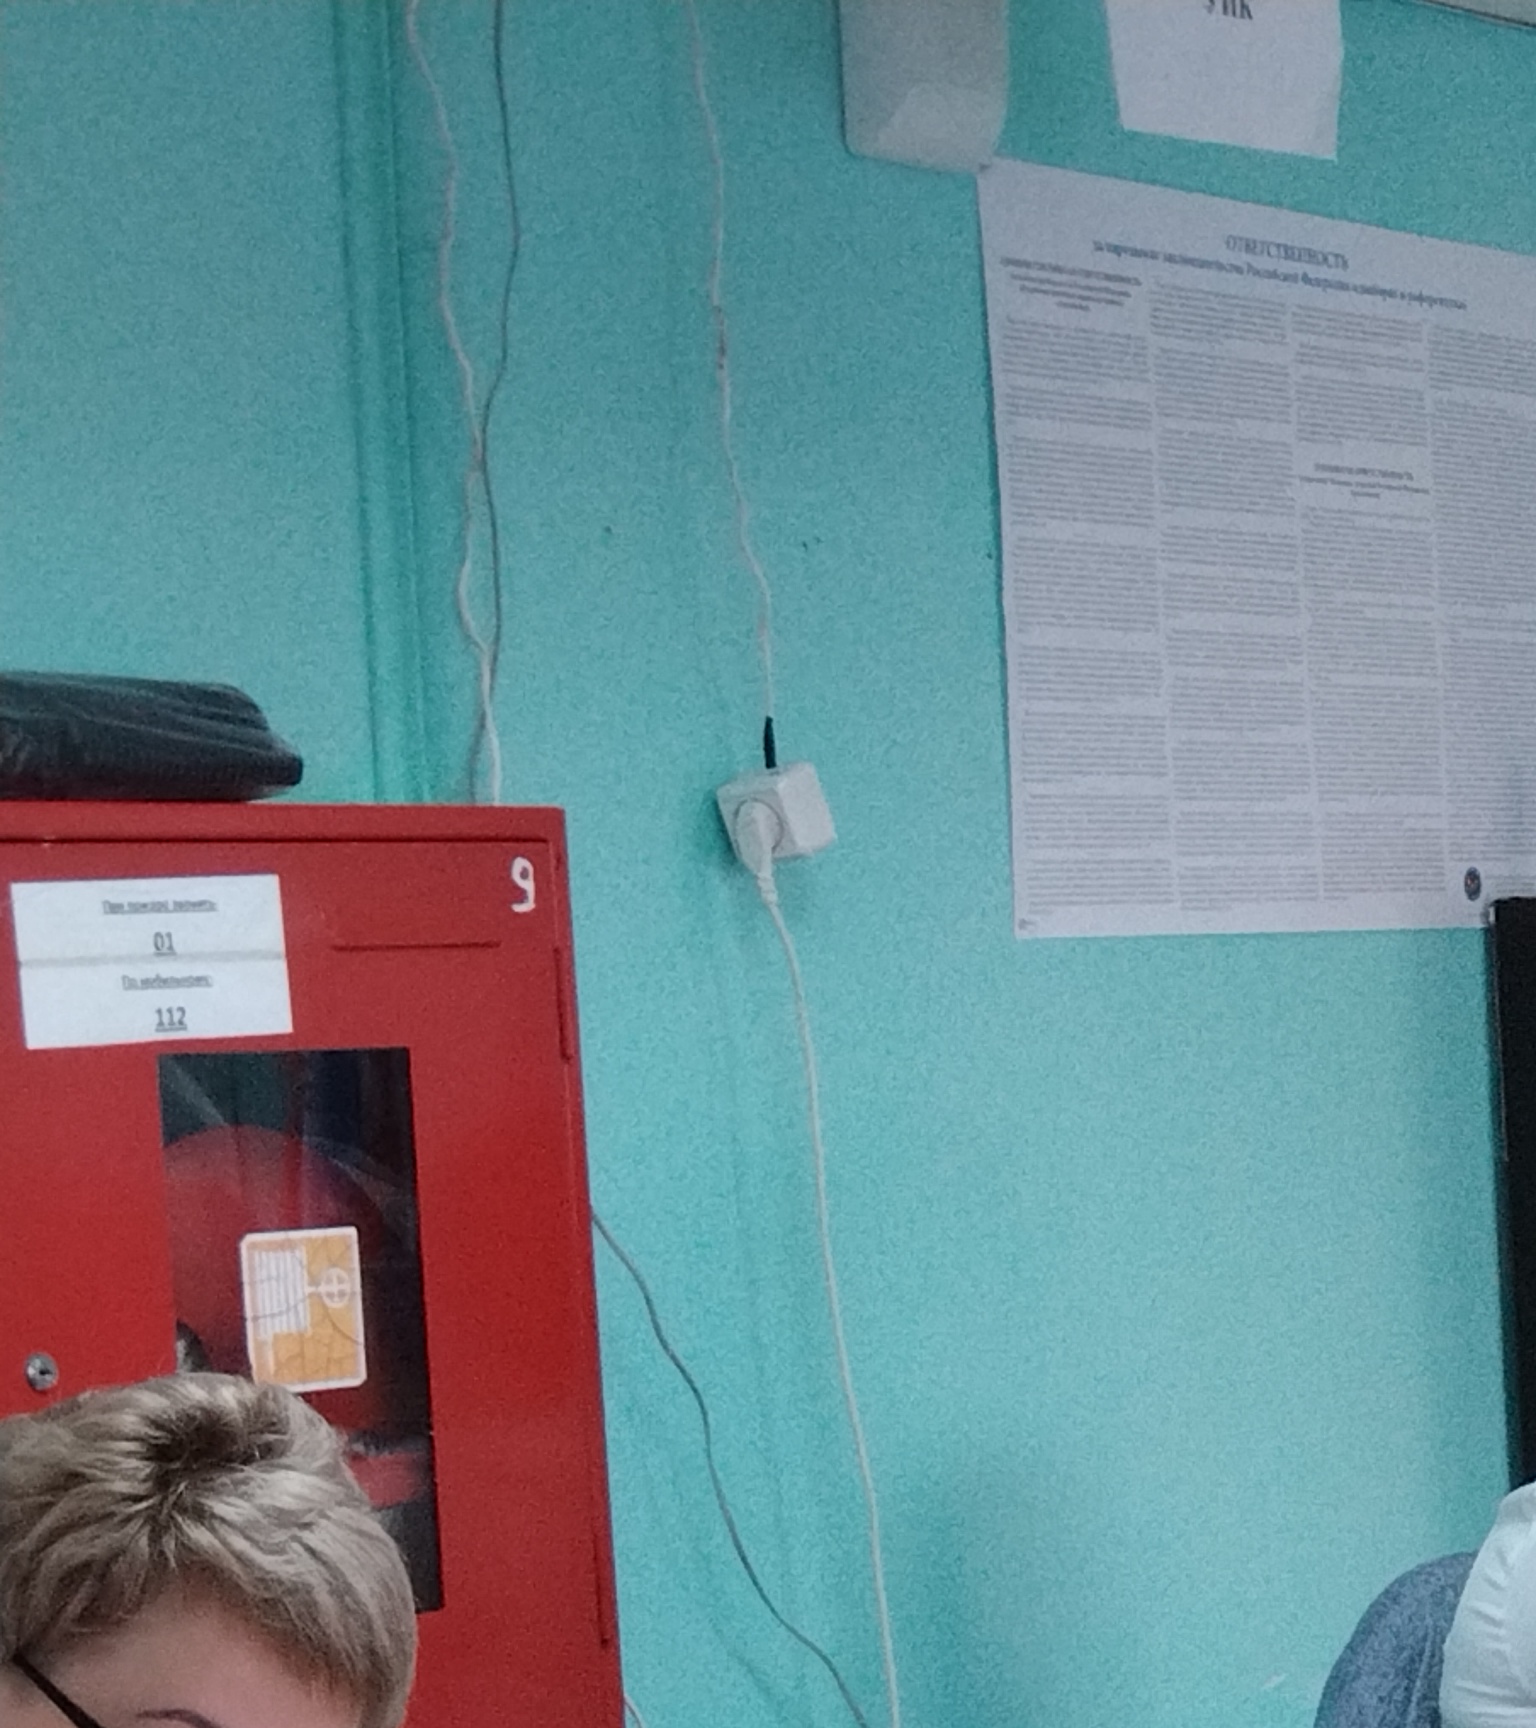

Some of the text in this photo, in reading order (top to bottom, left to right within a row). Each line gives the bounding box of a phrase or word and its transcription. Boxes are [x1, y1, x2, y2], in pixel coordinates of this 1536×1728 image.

[510, 856, 536, 913] 9
[153, 931, 176, 953] 01
[155, 1006, 187, 1029] 112
